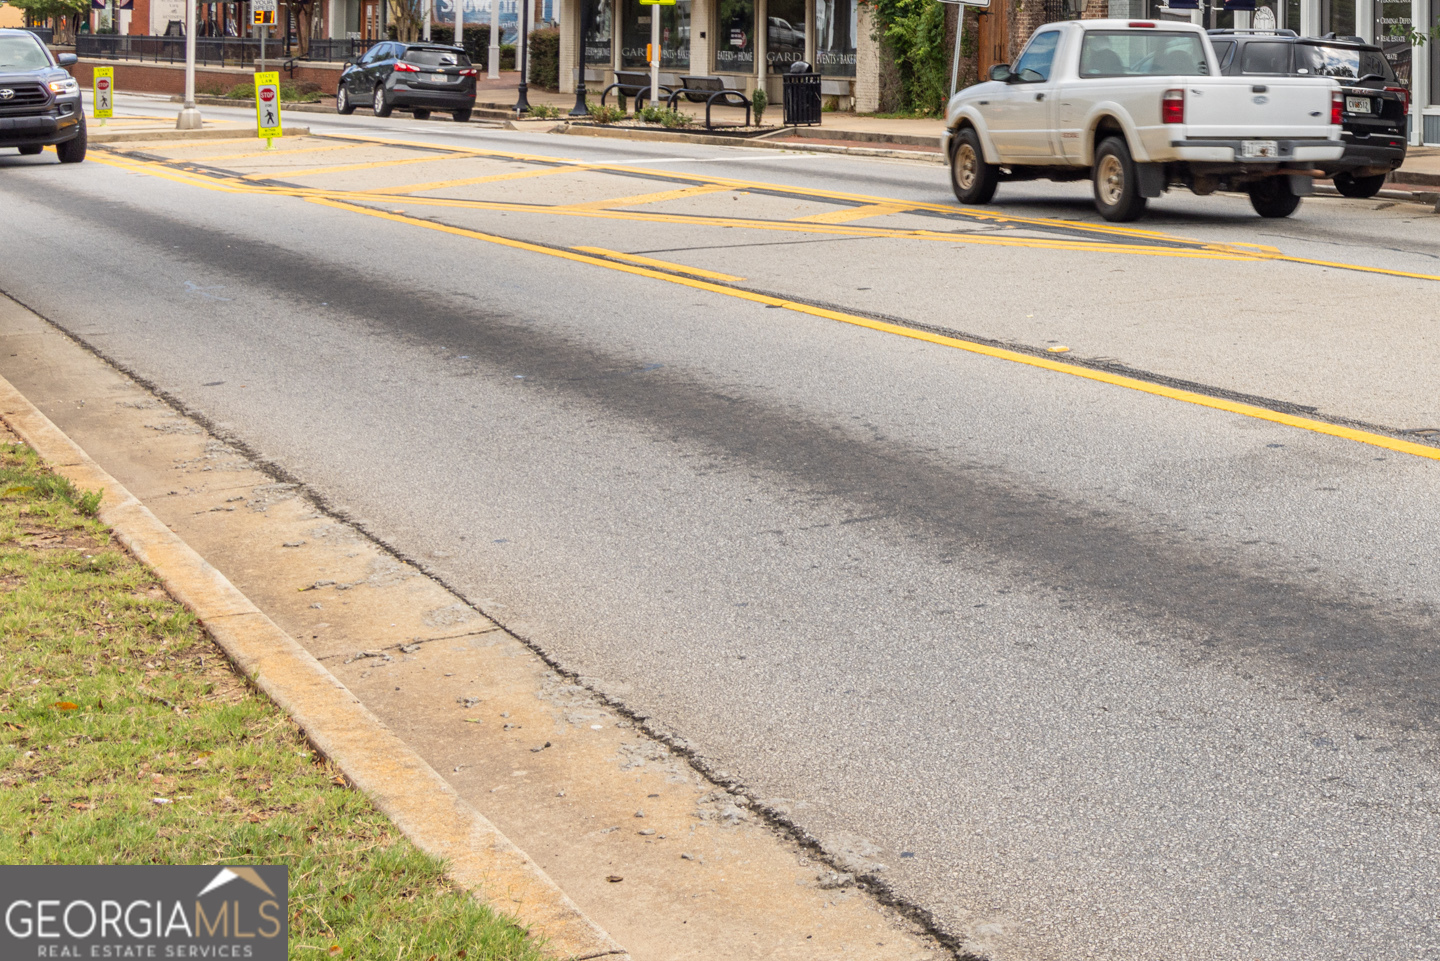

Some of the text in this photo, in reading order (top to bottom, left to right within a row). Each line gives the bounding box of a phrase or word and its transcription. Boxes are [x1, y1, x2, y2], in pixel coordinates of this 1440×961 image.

[254, 11, 275, 24] 31
[717, 50, 753, 62] EATERY HOME
[816, 54, 836, 64] EVENTS
